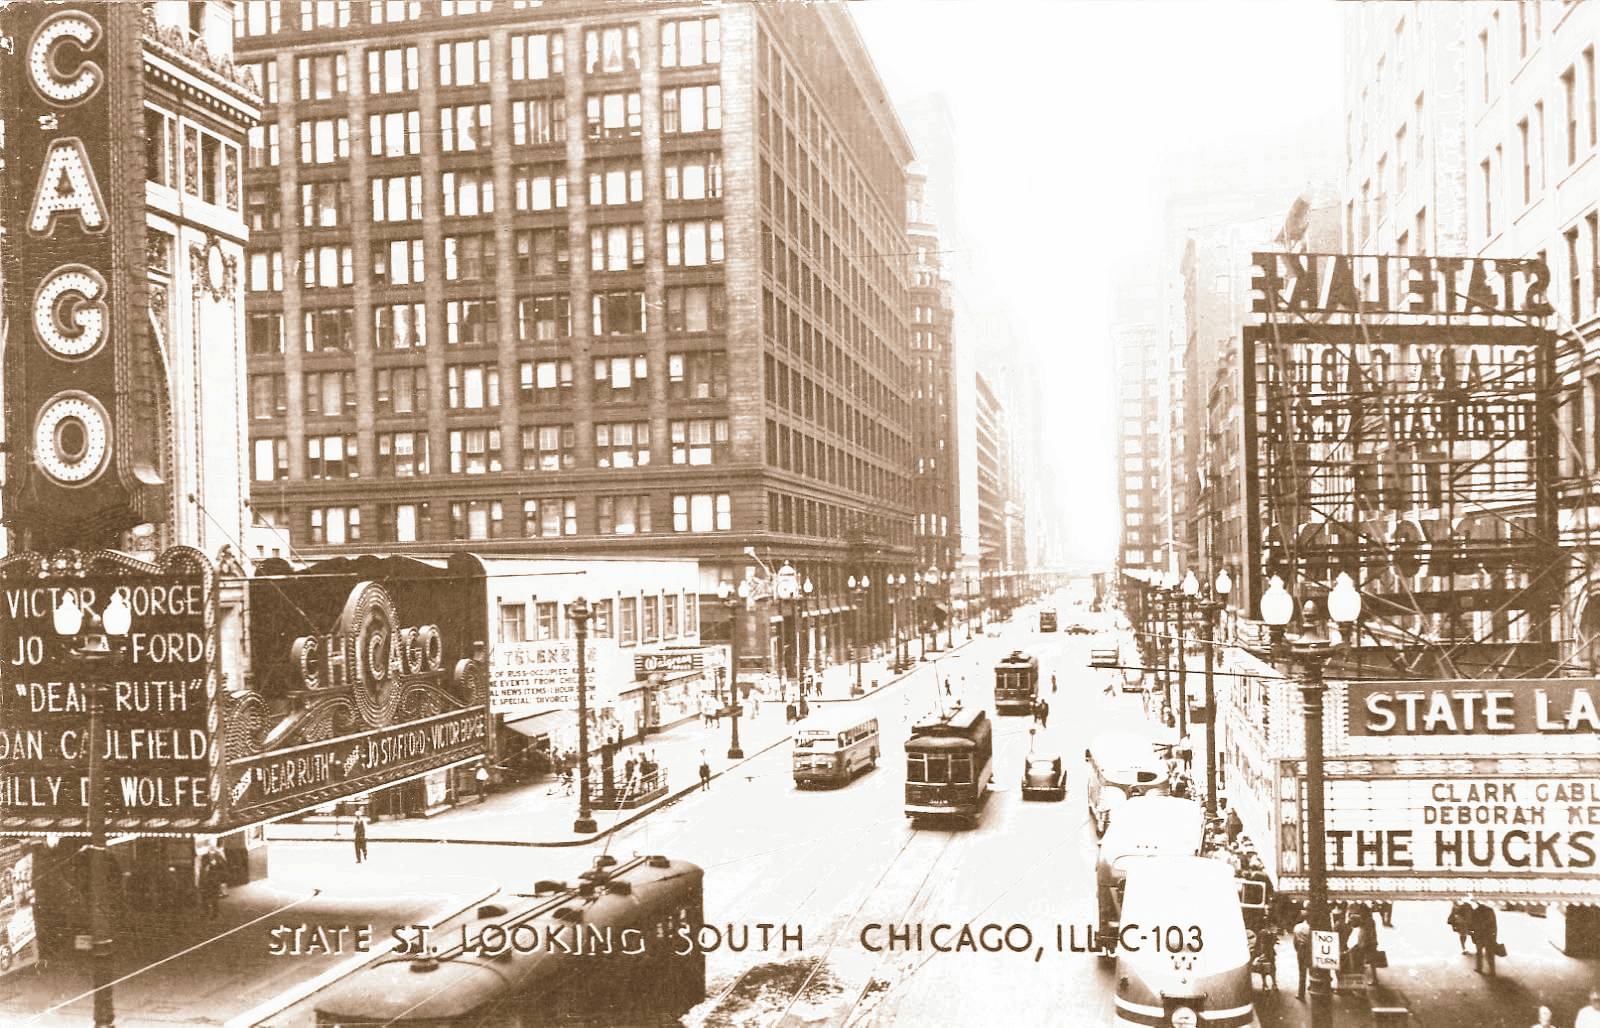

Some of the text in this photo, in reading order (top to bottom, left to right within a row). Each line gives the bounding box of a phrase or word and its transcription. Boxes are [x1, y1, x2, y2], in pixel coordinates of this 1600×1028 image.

[11, 635, 43, 666] JO
[1365, 688, 1600, 732] STATE LA
[0, 775, 62, 807] ILLY
[120, 775, 208, 808] WOLFE
[1431, 783, 1517, 803] CLARK
[1423, 805, 1545, 825] DEBORAH
[1326, 828, 1597, 869] THE HUCKS
[1318, 934, 1333, 943] NO
[1321, 944, 1330, 955] U
